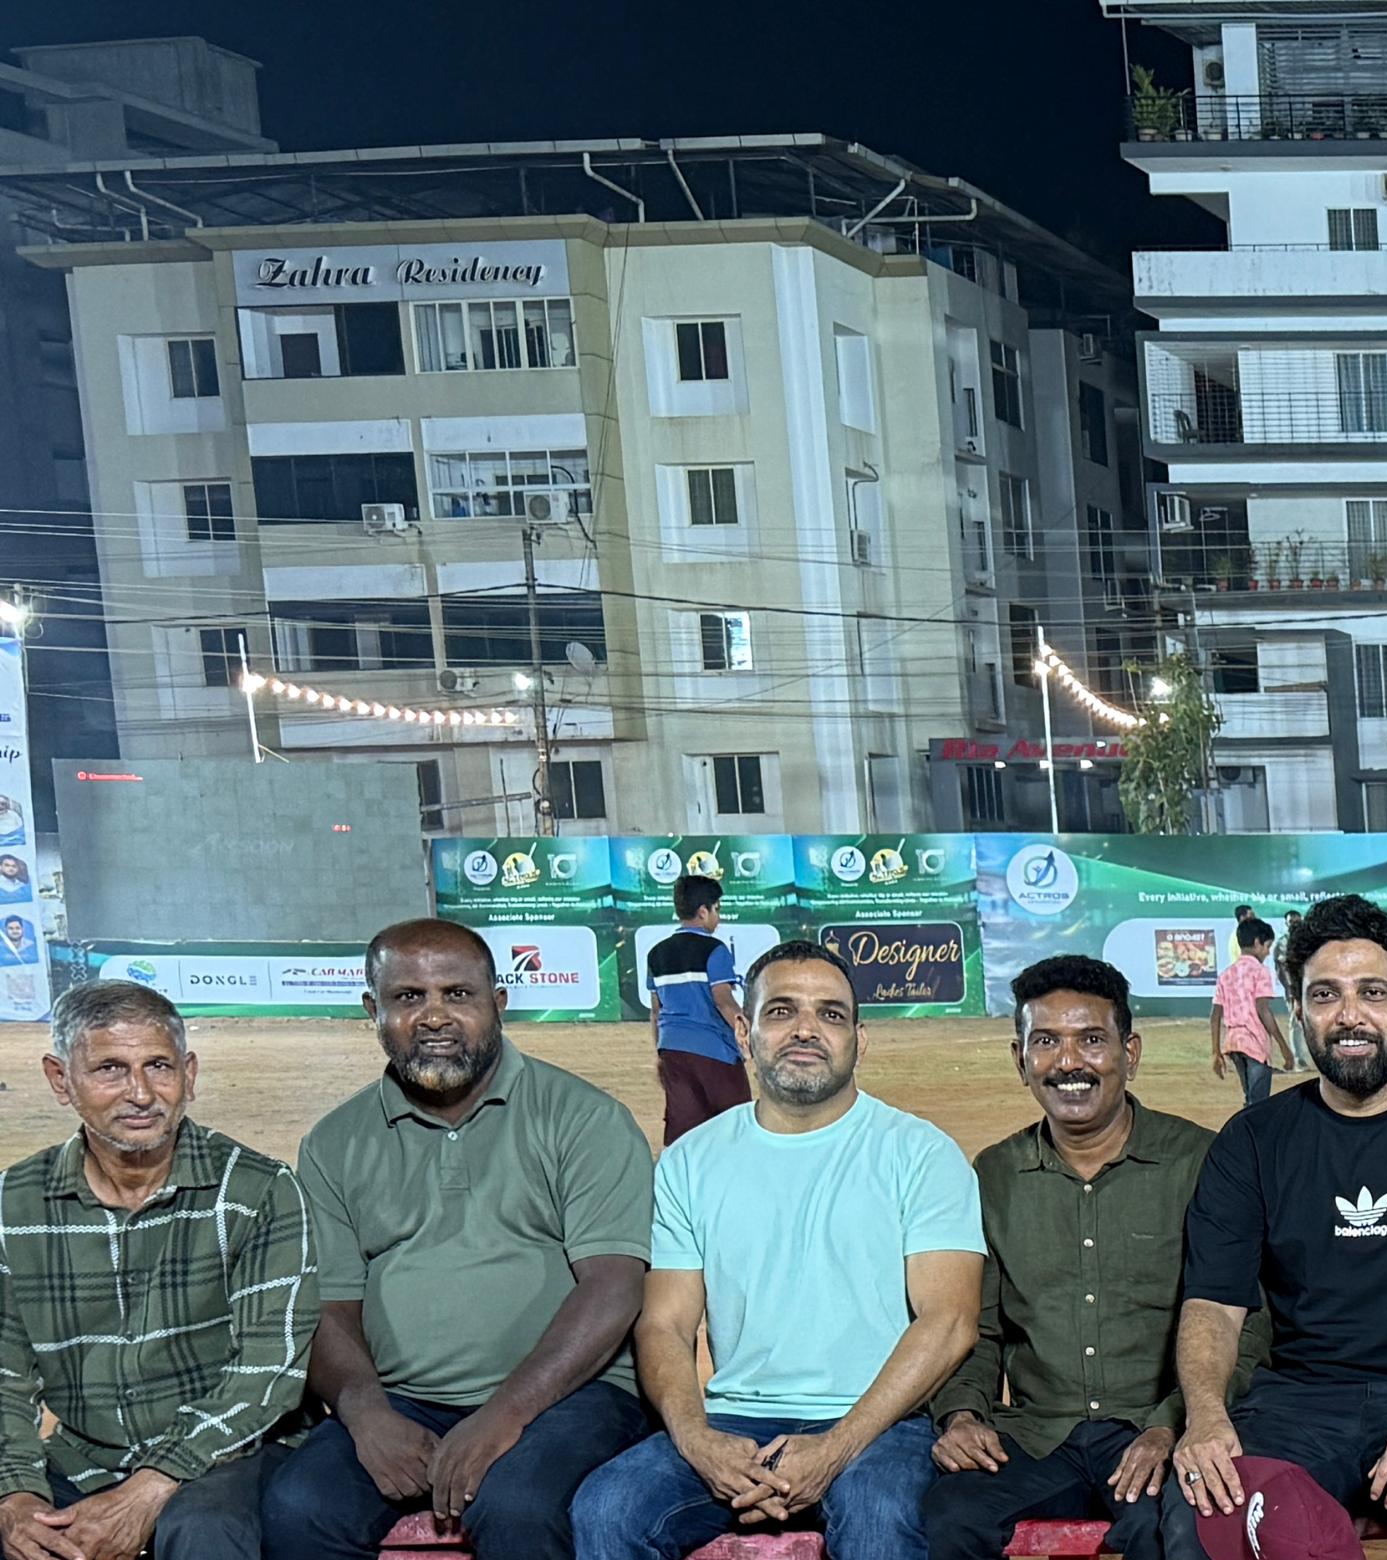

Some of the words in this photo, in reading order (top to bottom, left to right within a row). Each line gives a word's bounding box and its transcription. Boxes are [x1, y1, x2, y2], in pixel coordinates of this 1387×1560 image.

[256, 255, 374, 287] Zahra
[397, 256, 543, 286] Residency
[1008, 738, 1129, 759] Avenu
[1019, 892, 1070, 900] ACTROS
[1139, 892, 1165, 904] Every
[1168, 891, 1209, 903] initiative,
[1211, 890, 1250, 903] whether
[1252, 890, 1265, 903] big
[1267, 892, 1278, 902] or
[848, 931, 961, 981] Designer
[190, 974, 257, 986] DONGLE
[497, 972, 524, 985] ACK
[529, 972, 579, 984] STONE
